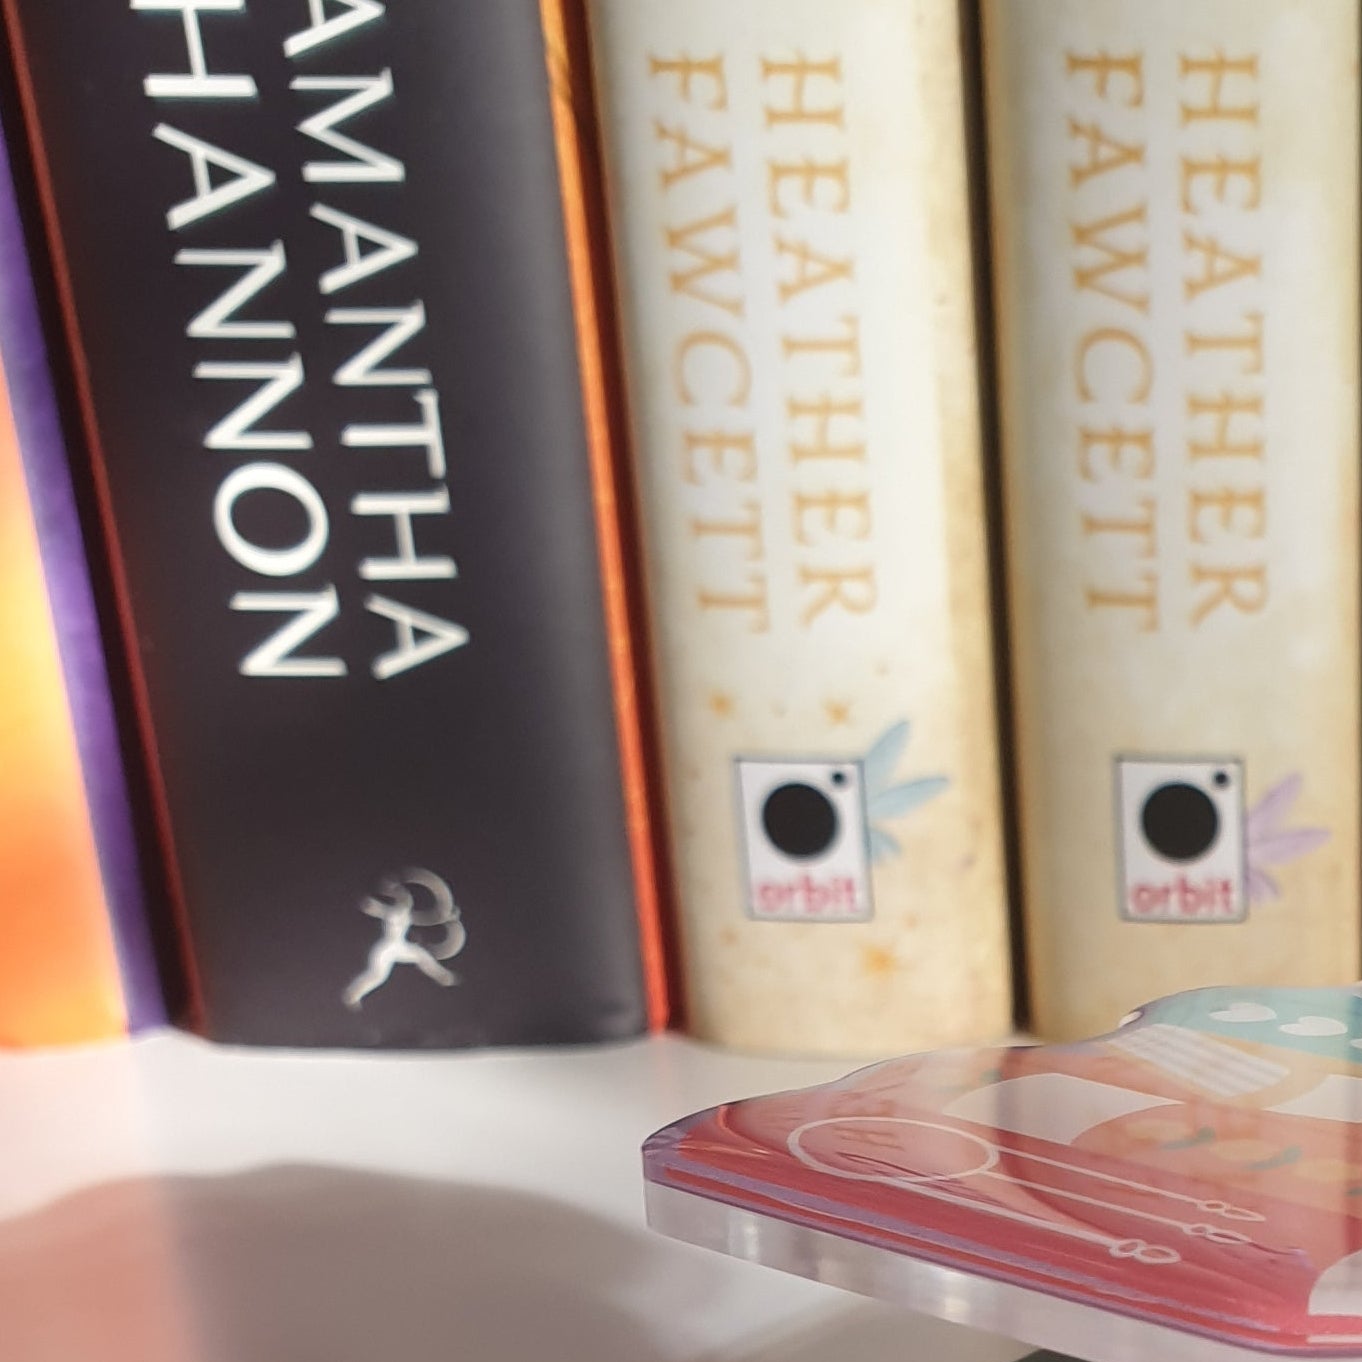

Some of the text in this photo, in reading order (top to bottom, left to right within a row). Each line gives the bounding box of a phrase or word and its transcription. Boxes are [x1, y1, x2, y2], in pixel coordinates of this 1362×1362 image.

[129, 0, 348, 677] HANNON
[646, 51, 770, 634] FAWCETT
[759, 53, 878, 629] HEATHER
[1063, 50, 1159, 633] FAWCETT
[1177, 50, 1268, 628] HEATHER
[1129, 874, 1234, 914] orbit
